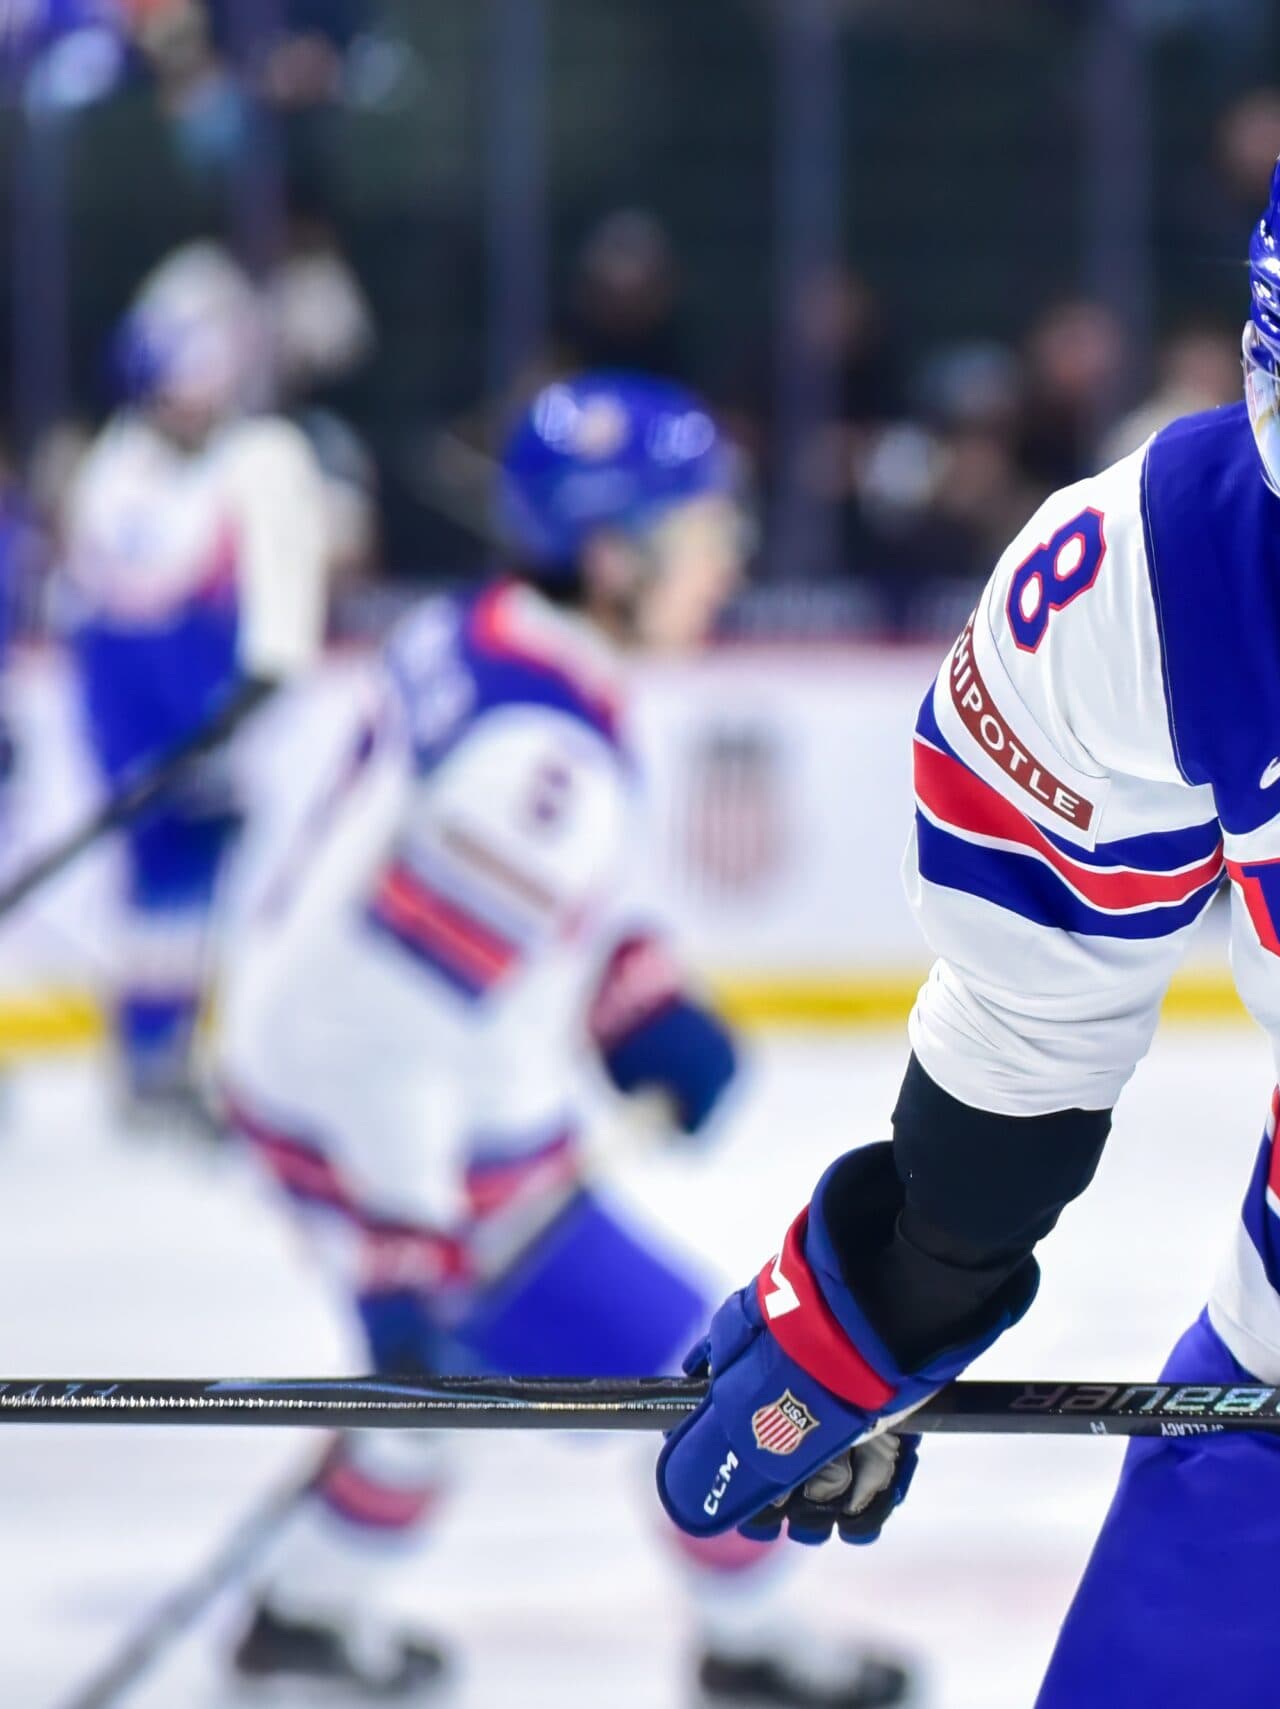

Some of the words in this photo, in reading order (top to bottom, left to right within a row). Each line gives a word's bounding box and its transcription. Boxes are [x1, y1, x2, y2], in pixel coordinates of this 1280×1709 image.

[1005, 506, 1107, 654] 8
[953, 628, 1080, 818] HIPOTLE
[781, 1400, 809, 1430] USA
[703, 1449, 739, 1516] CCM
